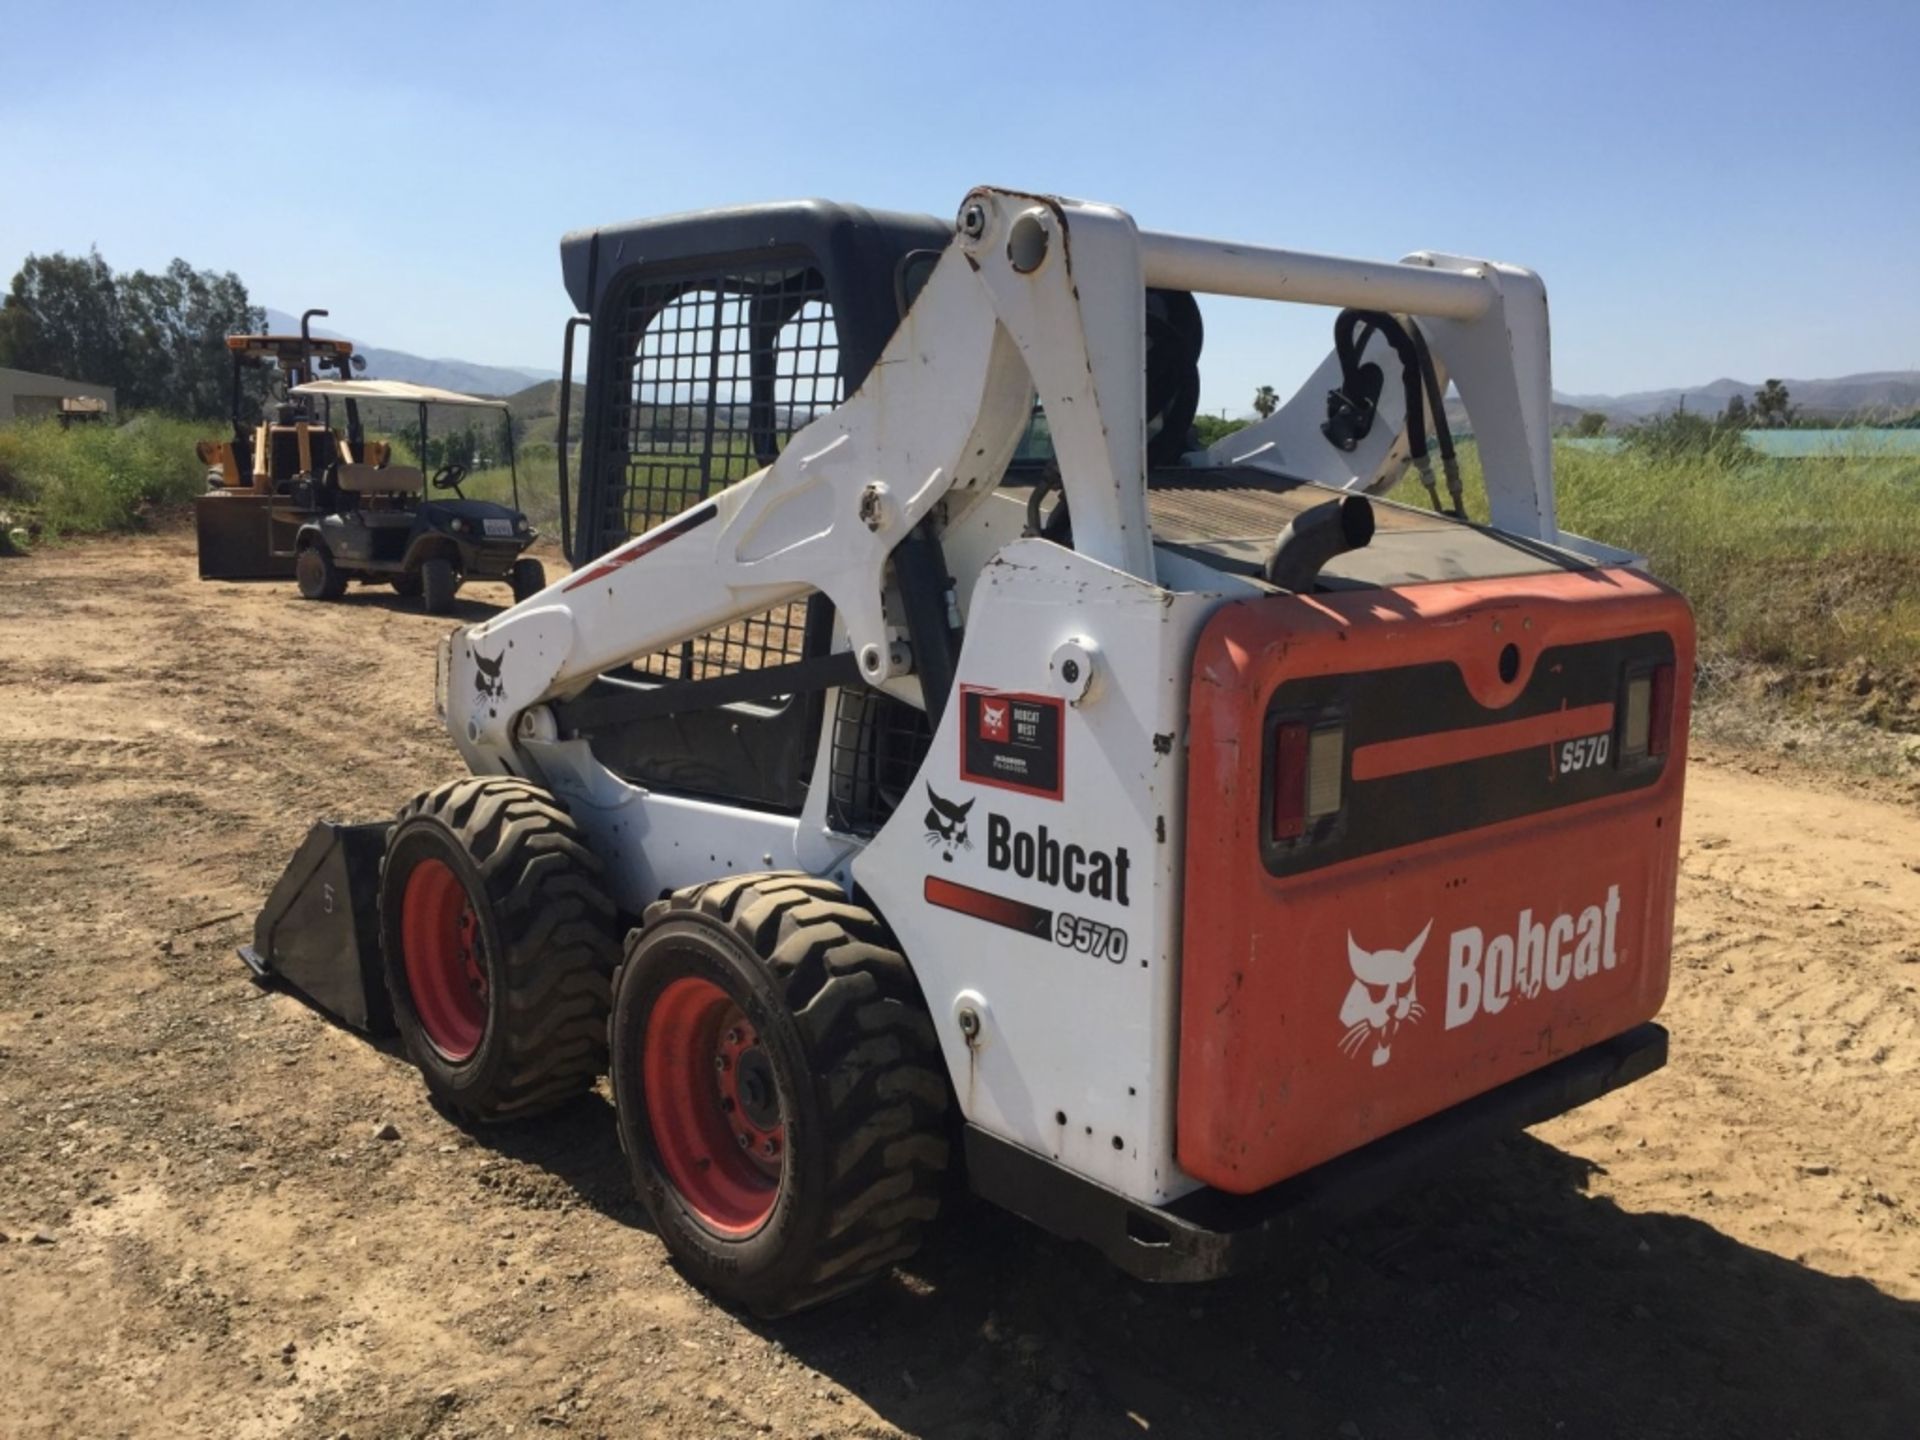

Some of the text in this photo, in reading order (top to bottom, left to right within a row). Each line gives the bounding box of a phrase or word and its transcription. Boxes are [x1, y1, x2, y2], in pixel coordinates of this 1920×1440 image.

[1014, 708, 1040, 723] BOBCAT
[1560, 734, 1609, 773] S570
[988, 812, 1130, 906] Bobcat
[1056, 913, 1128, 963] S570
[1445, 885, 1621, 1030] Bobcat
